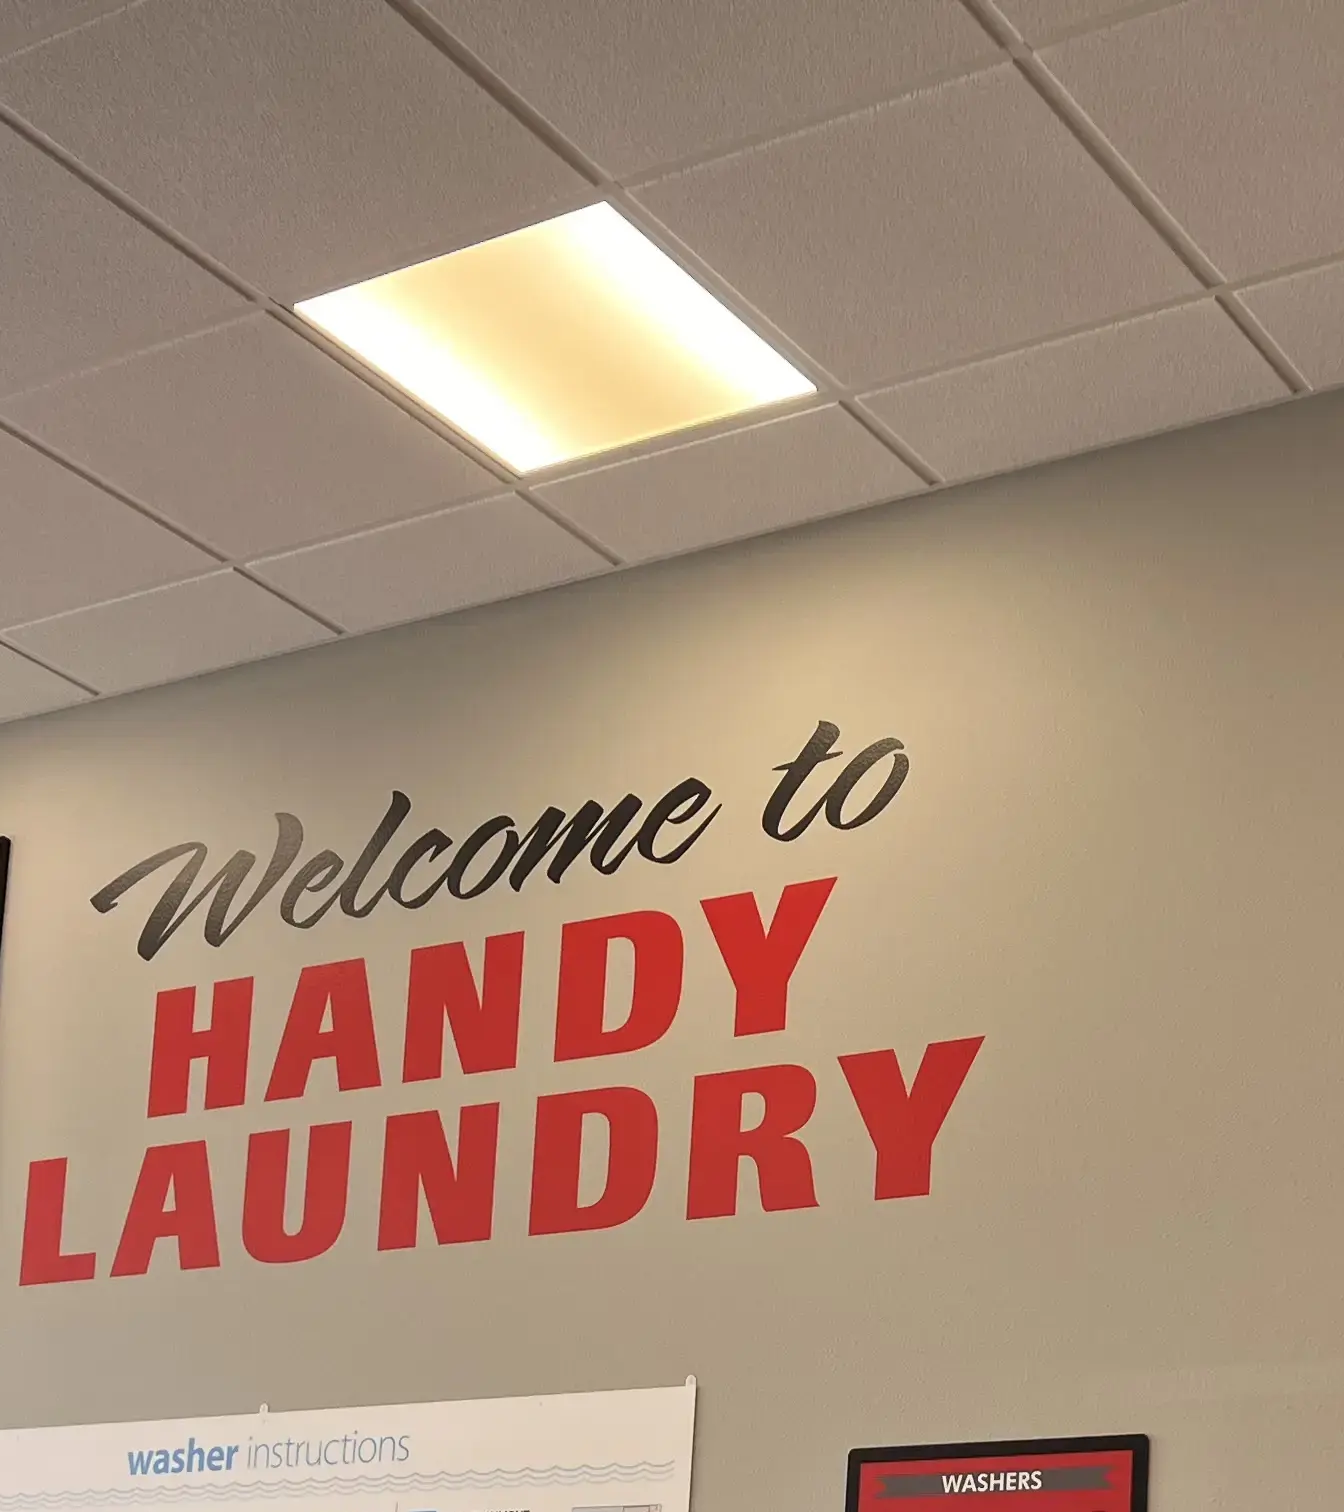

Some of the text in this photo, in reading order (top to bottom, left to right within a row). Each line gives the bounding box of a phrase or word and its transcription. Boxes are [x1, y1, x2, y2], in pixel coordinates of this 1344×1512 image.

[91, 720, 908, 961] Welcome to
[147, 876, 838, 1119] HANDY
[19, 1035, 985, 1288] LAUNDRY
[127, 1430, 411, 1476] washer instructions
[942, 1471, 1043, 1493] WASHERS
